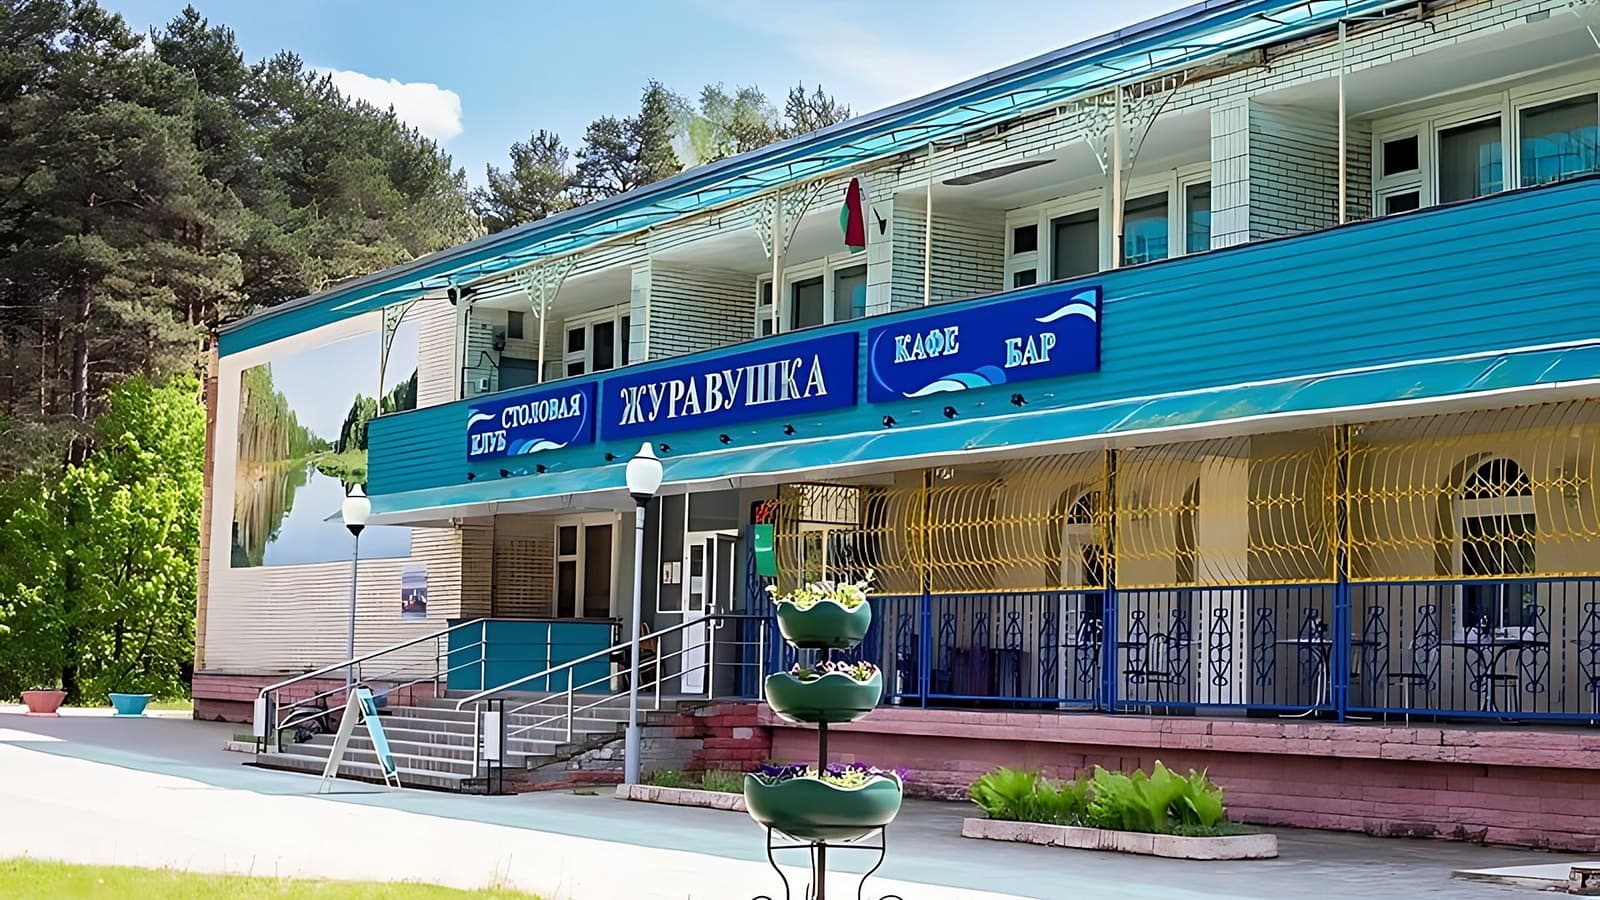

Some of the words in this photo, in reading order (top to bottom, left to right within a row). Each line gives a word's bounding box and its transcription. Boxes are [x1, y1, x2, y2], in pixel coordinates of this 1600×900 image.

[894, 326, 959, 363] КАФЕ
[1004, 332, 1056, 368] БАР
[619, 353, 828, 425] ЖУРАВУШКА
[501, 393, 581, 428] СТОЛОВАЯ
[470, 430, 506, 456] КЛУБ
